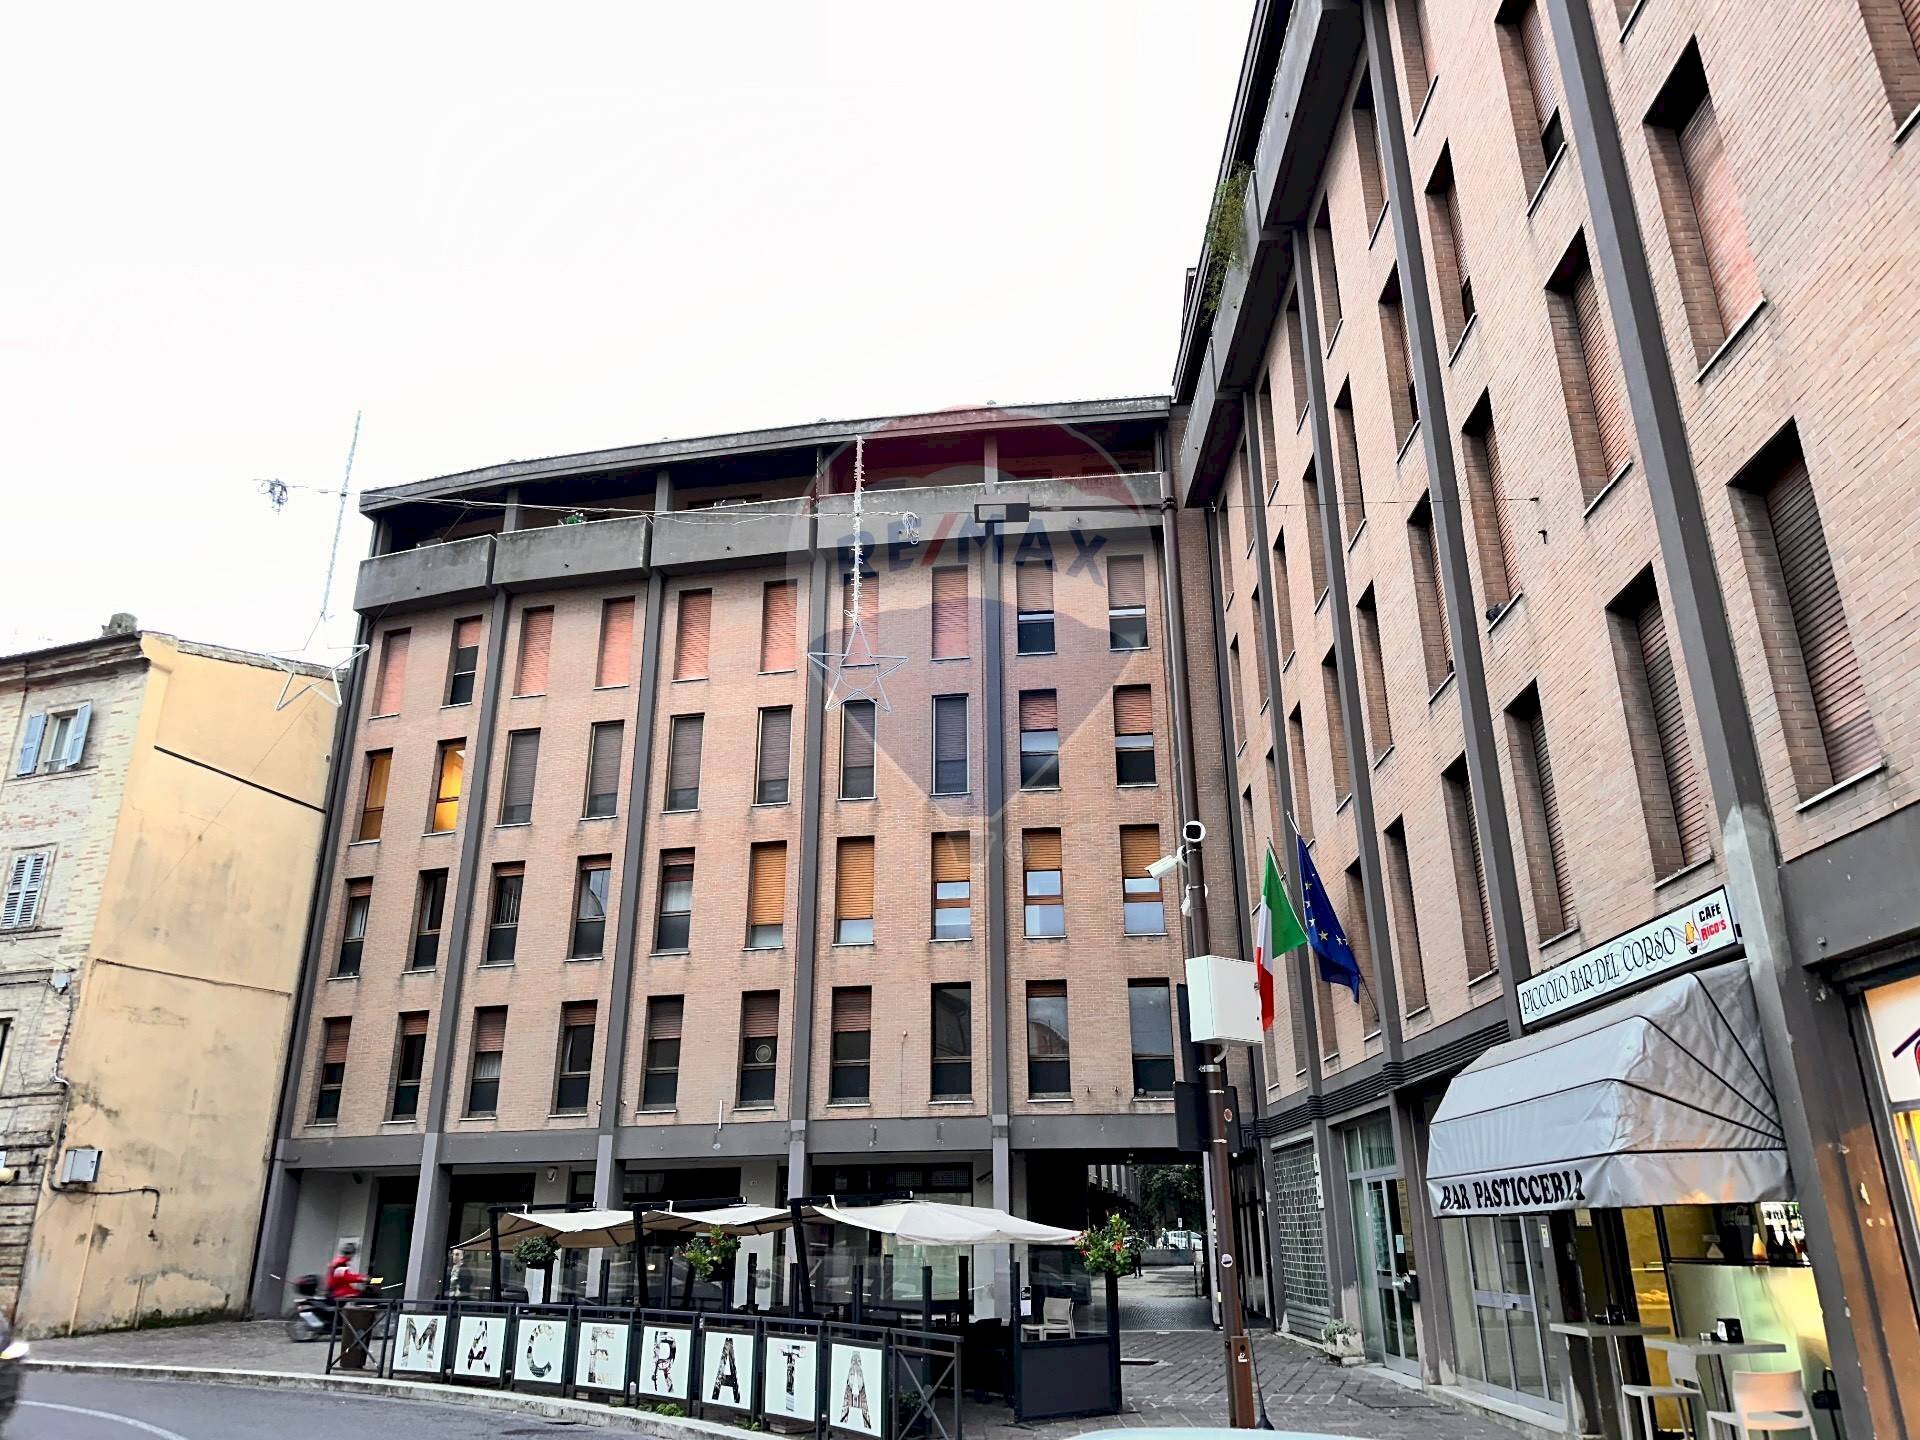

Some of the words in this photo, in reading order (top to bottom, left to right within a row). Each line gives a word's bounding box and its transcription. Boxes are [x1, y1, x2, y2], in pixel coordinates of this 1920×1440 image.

[1699, 903, 1722, 923] CAFE
[1700, 919, 1728, 942] RICO'S
[1521, 974, 1570, 1015] PICCOLO
[1570, 963, 1594, 996] BAR
[1594, 952, 1620, 985] DEL
[1622, 926, 1677, 973] CORSO
[1439, 1183, 1472, 1210] BAR
[1472, 1169, 1586, 1209] PASTICCERIA
